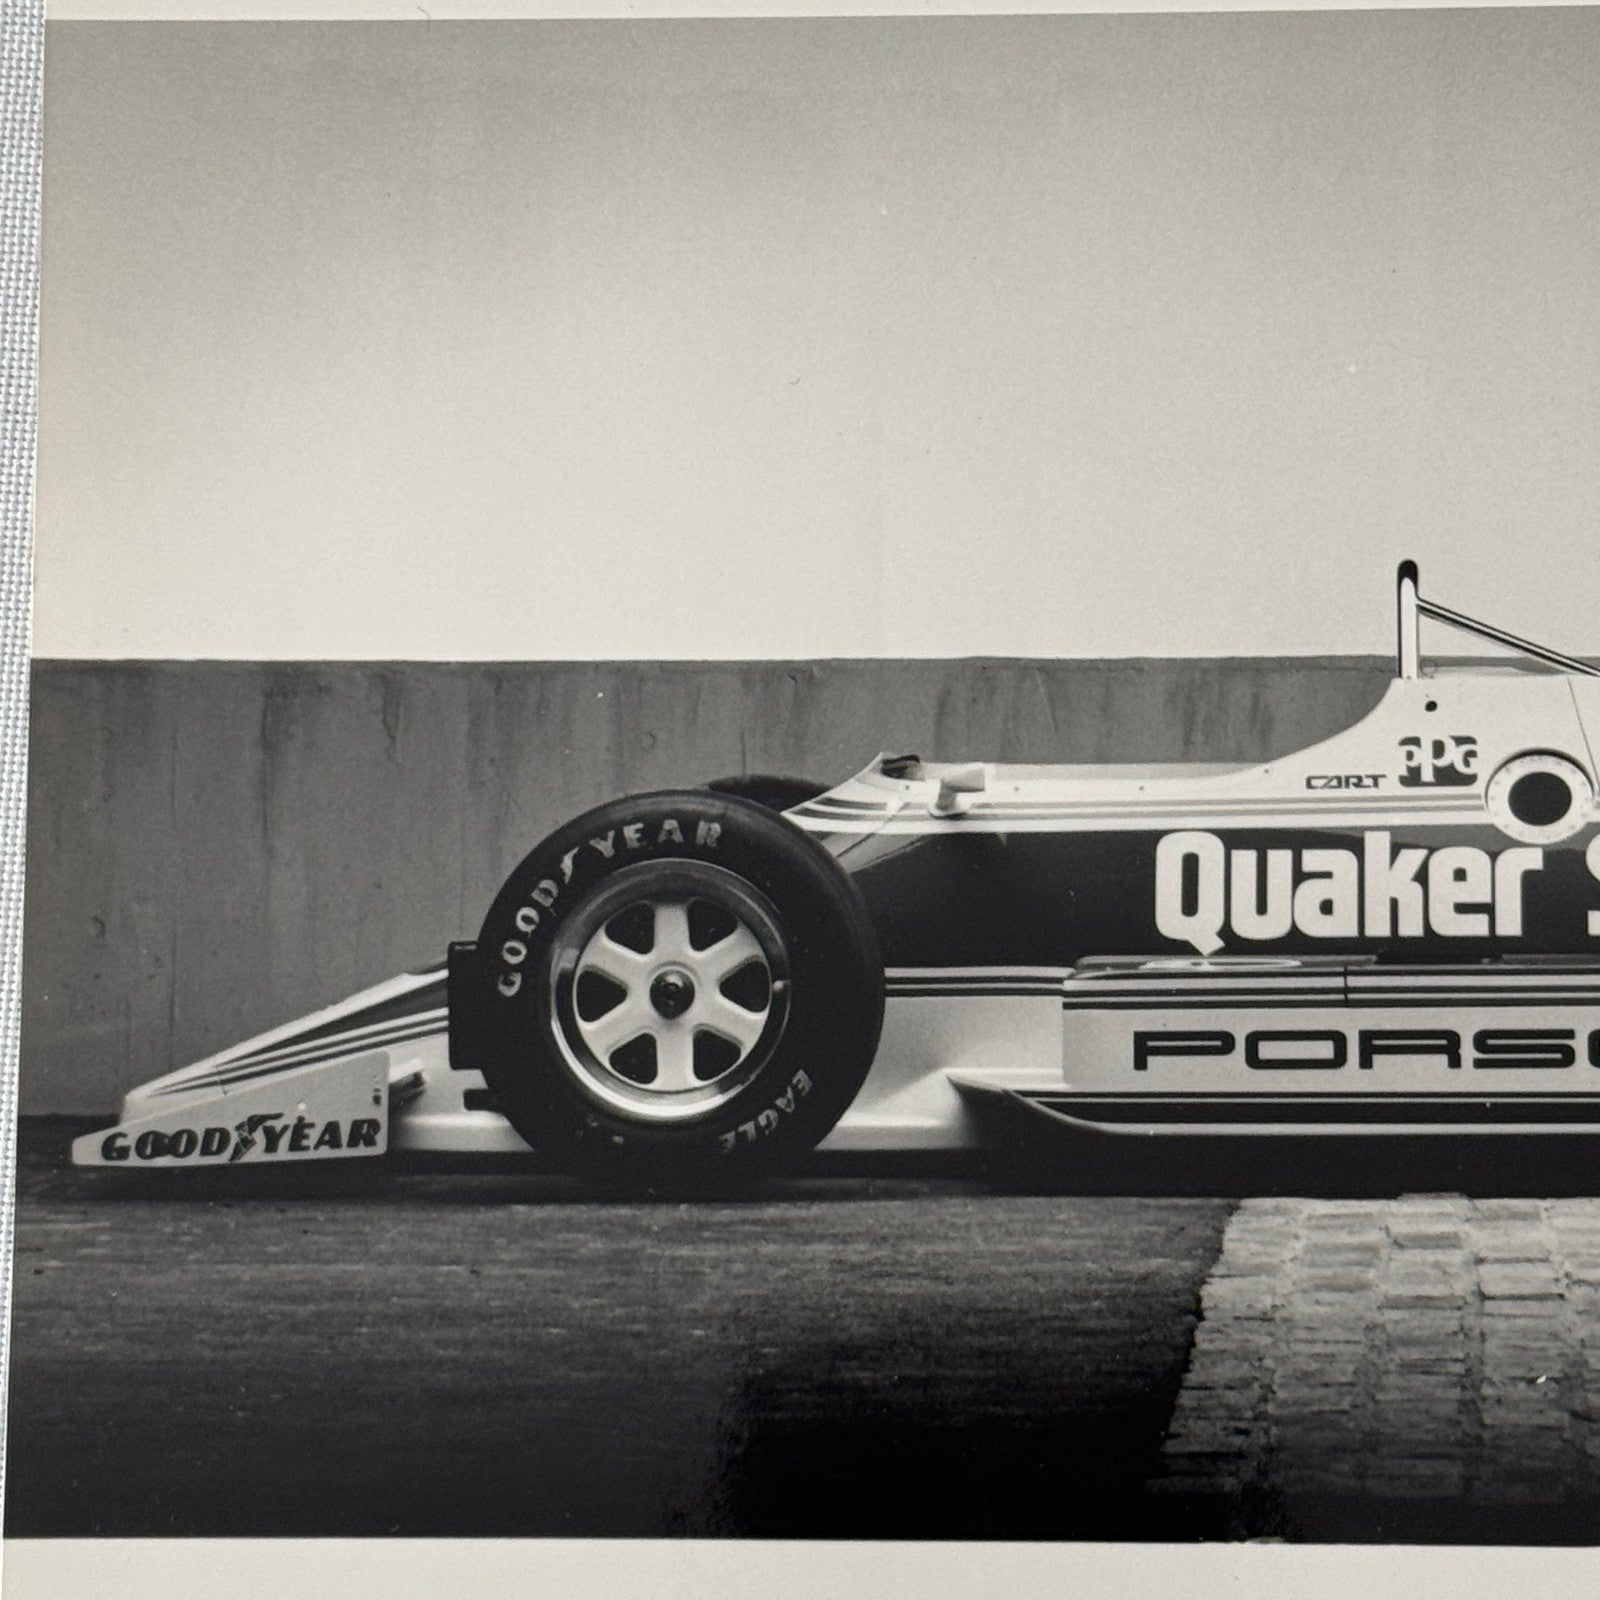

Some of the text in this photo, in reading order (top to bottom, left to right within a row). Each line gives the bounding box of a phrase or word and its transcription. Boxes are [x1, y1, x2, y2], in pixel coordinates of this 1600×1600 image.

[1305, 774, 1387, 790] CART
[1155, 831, 1544, 957] Quaker
[1133, 1029, 1600, 1070] PORS
